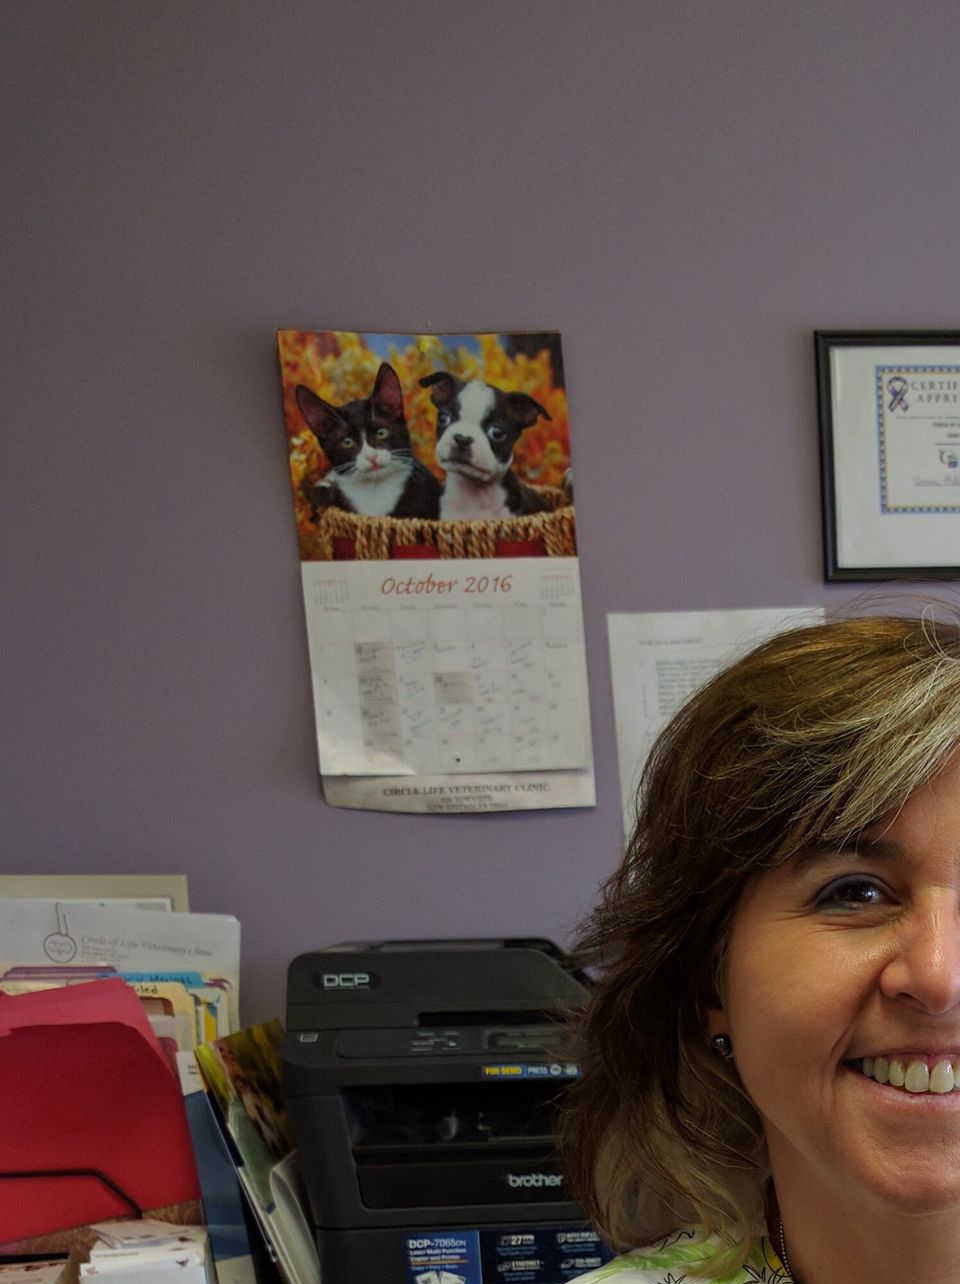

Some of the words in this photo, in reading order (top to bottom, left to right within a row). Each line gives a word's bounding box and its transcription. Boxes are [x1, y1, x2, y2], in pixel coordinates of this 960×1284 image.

[380, 573, 457, 595] October
[463, 575, 513, 593] 2016
[323, 973, 370, 987] DCP
[508, 1174, 563, 1188] brother
